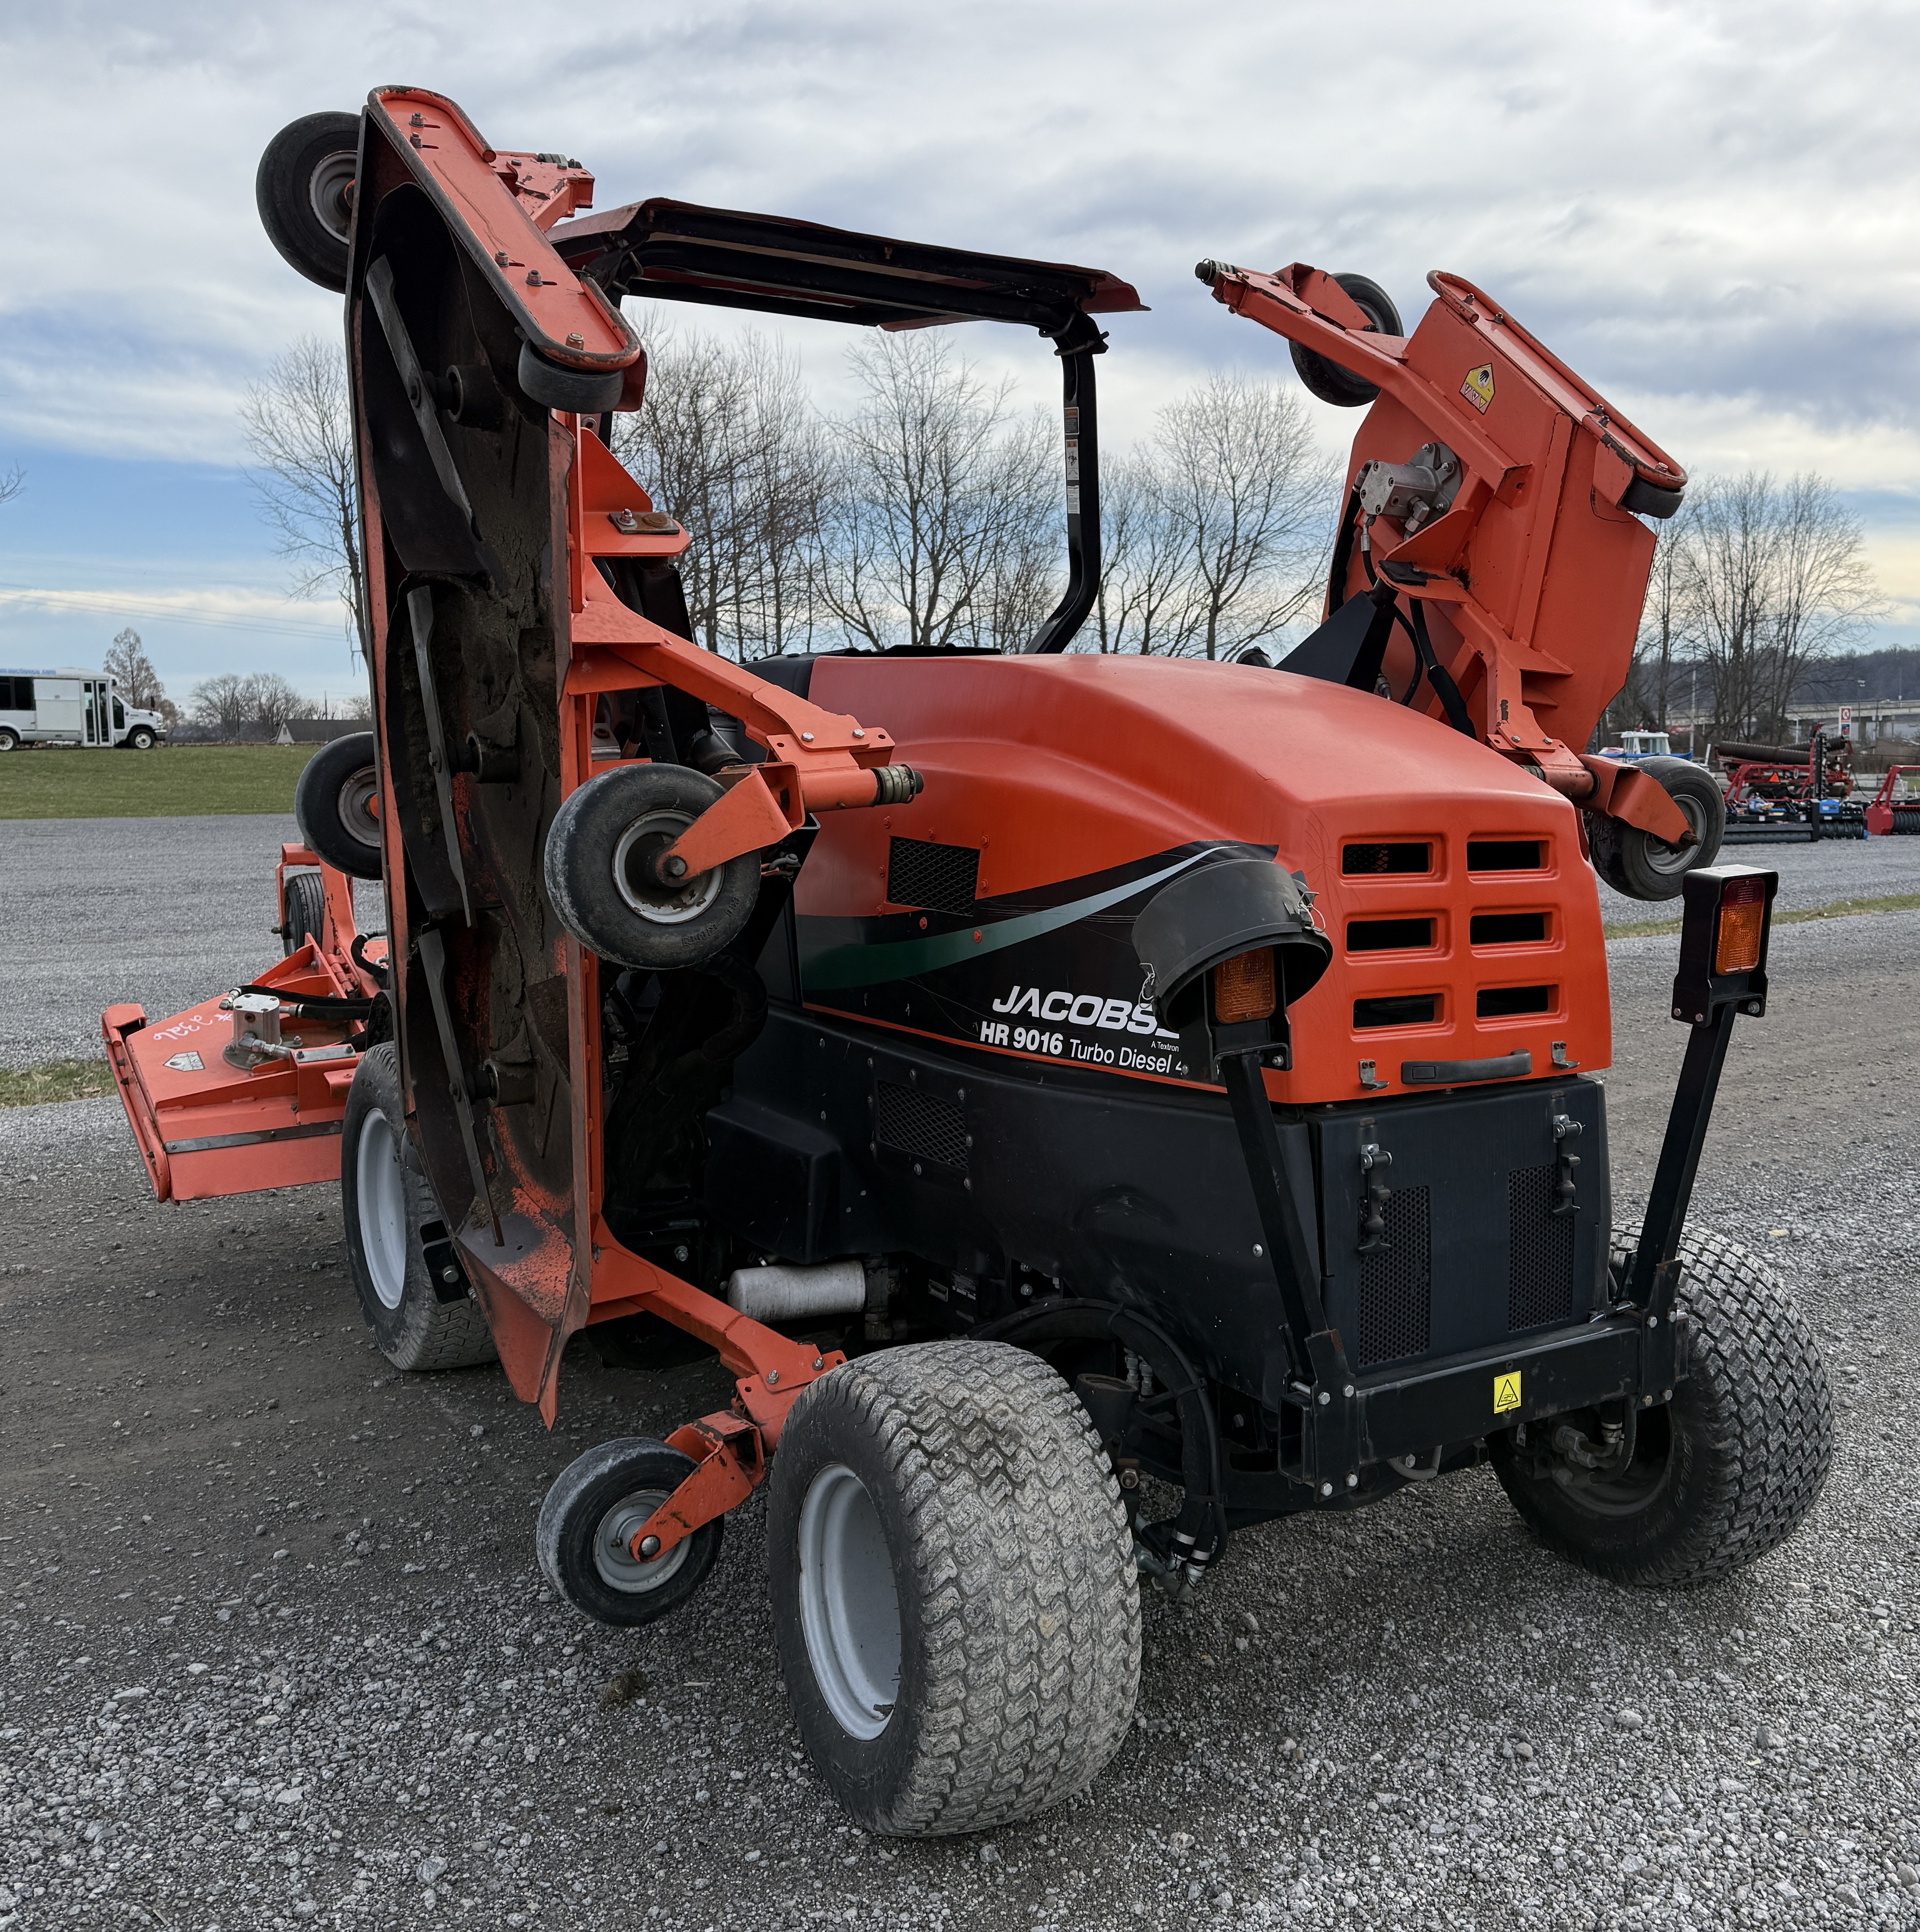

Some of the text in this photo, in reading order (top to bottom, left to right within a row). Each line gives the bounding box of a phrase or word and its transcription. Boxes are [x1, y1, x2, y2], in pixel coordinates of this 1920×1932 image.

[980, 1021, 1010, 1046] HR
[1013, 1027, 1063, 1055] 9016
[1070, 1039, 1115, 1064] Turbo
[1119, 1047, 1172, 1073] Diesel
